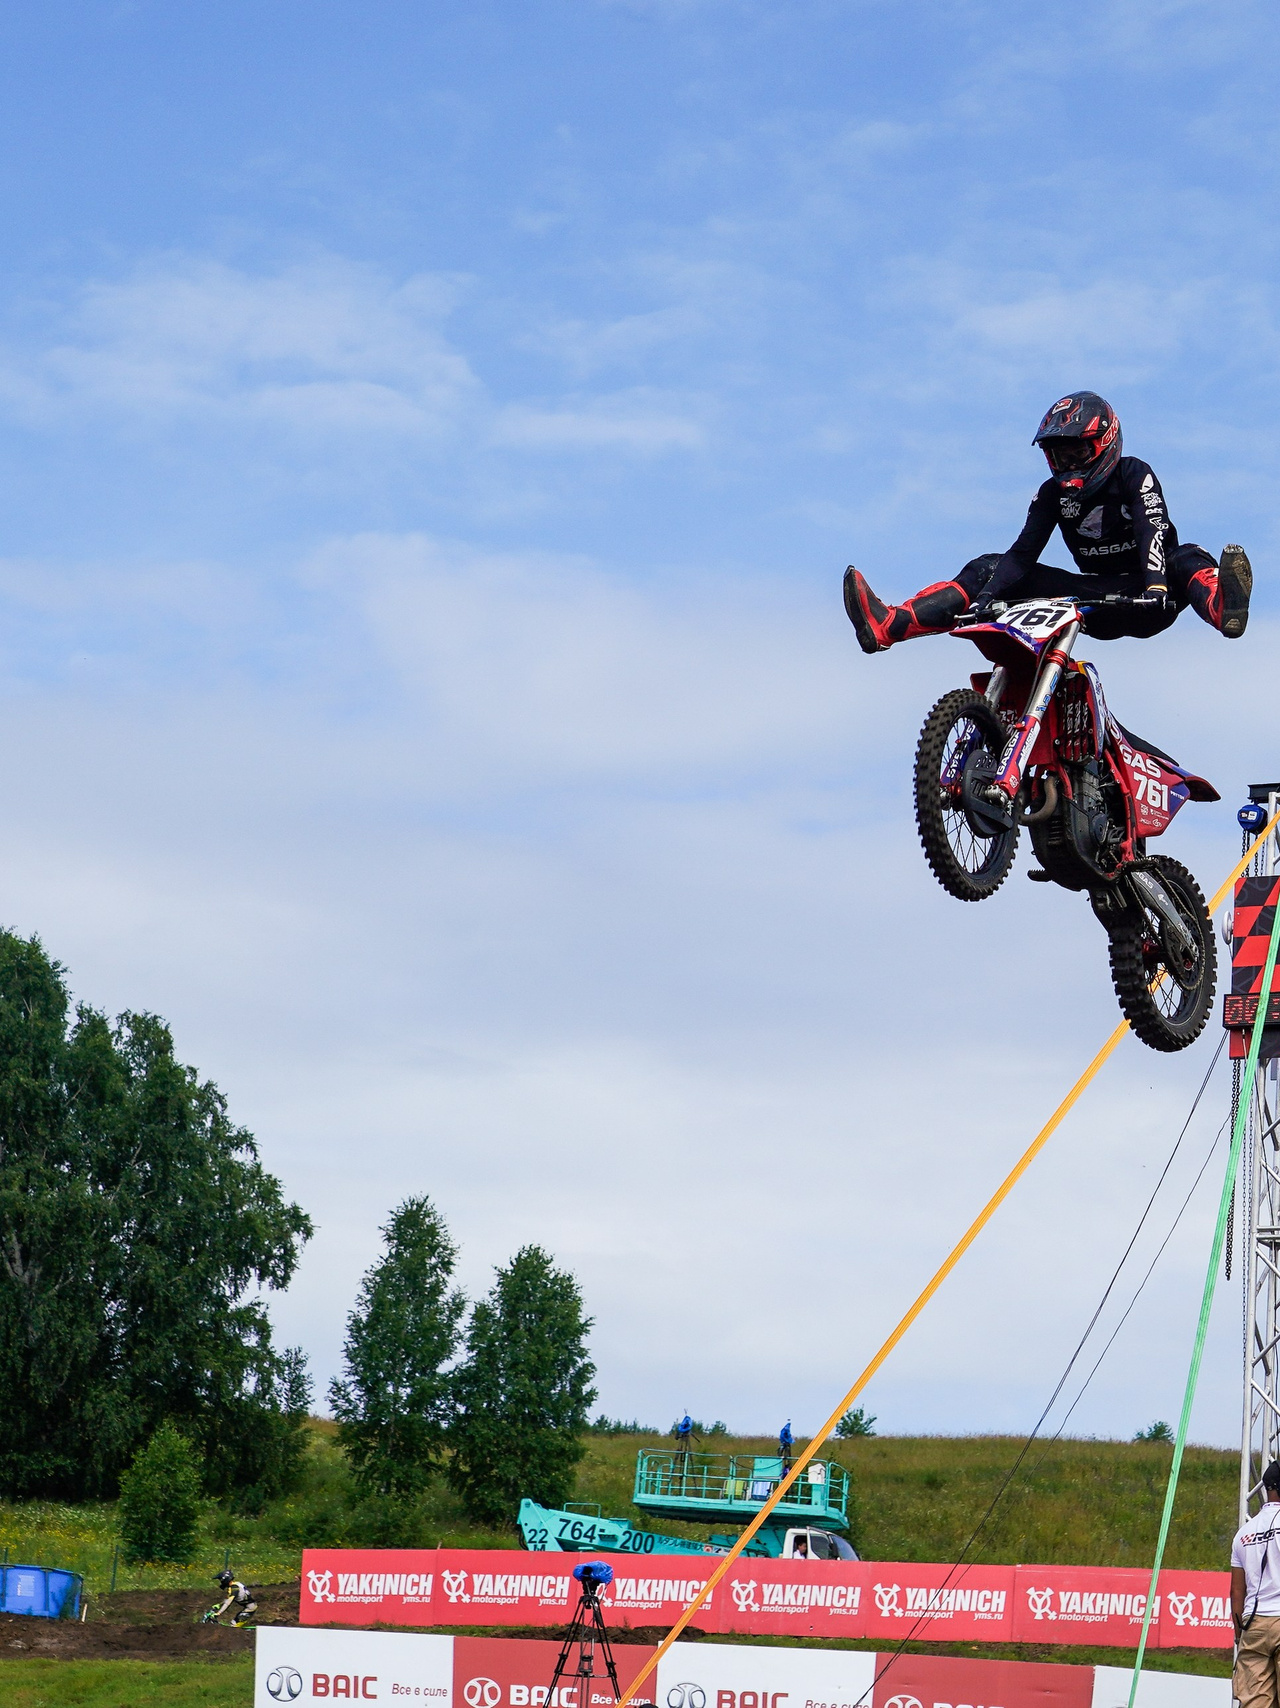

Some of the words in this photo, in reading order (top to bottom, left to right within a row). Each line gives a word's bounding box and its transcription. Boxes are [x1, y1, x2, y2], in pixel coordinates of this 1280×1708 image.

[1005, 607, 1069, 631] 761
[1133, 771, 1169, 812] 761
[528, 1528, 548, 1544] 22
[337, 1573, 434, 1596] YAKHNICH
[472, 1574, 570, 1598] YAKHNICH
[336, 1595, 384, 1604] motorsport
[402, 1596, 431, 1605] yms.ru
[471, 1596, 519, 1606] motorsport
[538, 1598, 568, 1607] yms.ru
[762, 1583, 861, 1608] YAKHNICH
[905, 1587, 1007, 1613] YAKHNICH
[613, 1600, 662, 1610] motorsport
[681, 1603, 711, 1611] y.ru
[761, 1605, 809, 1615] motorsport
[829, 1607, 859, 1616] yms.ru
[904, 1610, 954, 1620] motorsport
[973, 1612, 1004, 1621] yms.ru
[1058, 1613, 1108, 1623] motorsport
[312, 1673, 378, 1699] BAIC
[392, 1683, 412, 1696] Все
[414, 1686, 421, 1696] в
[423, 1687, 448, 1698] силе
[509, 1684, 578, 1708] BAIC
[590, 1693, 612, 1705] Все
